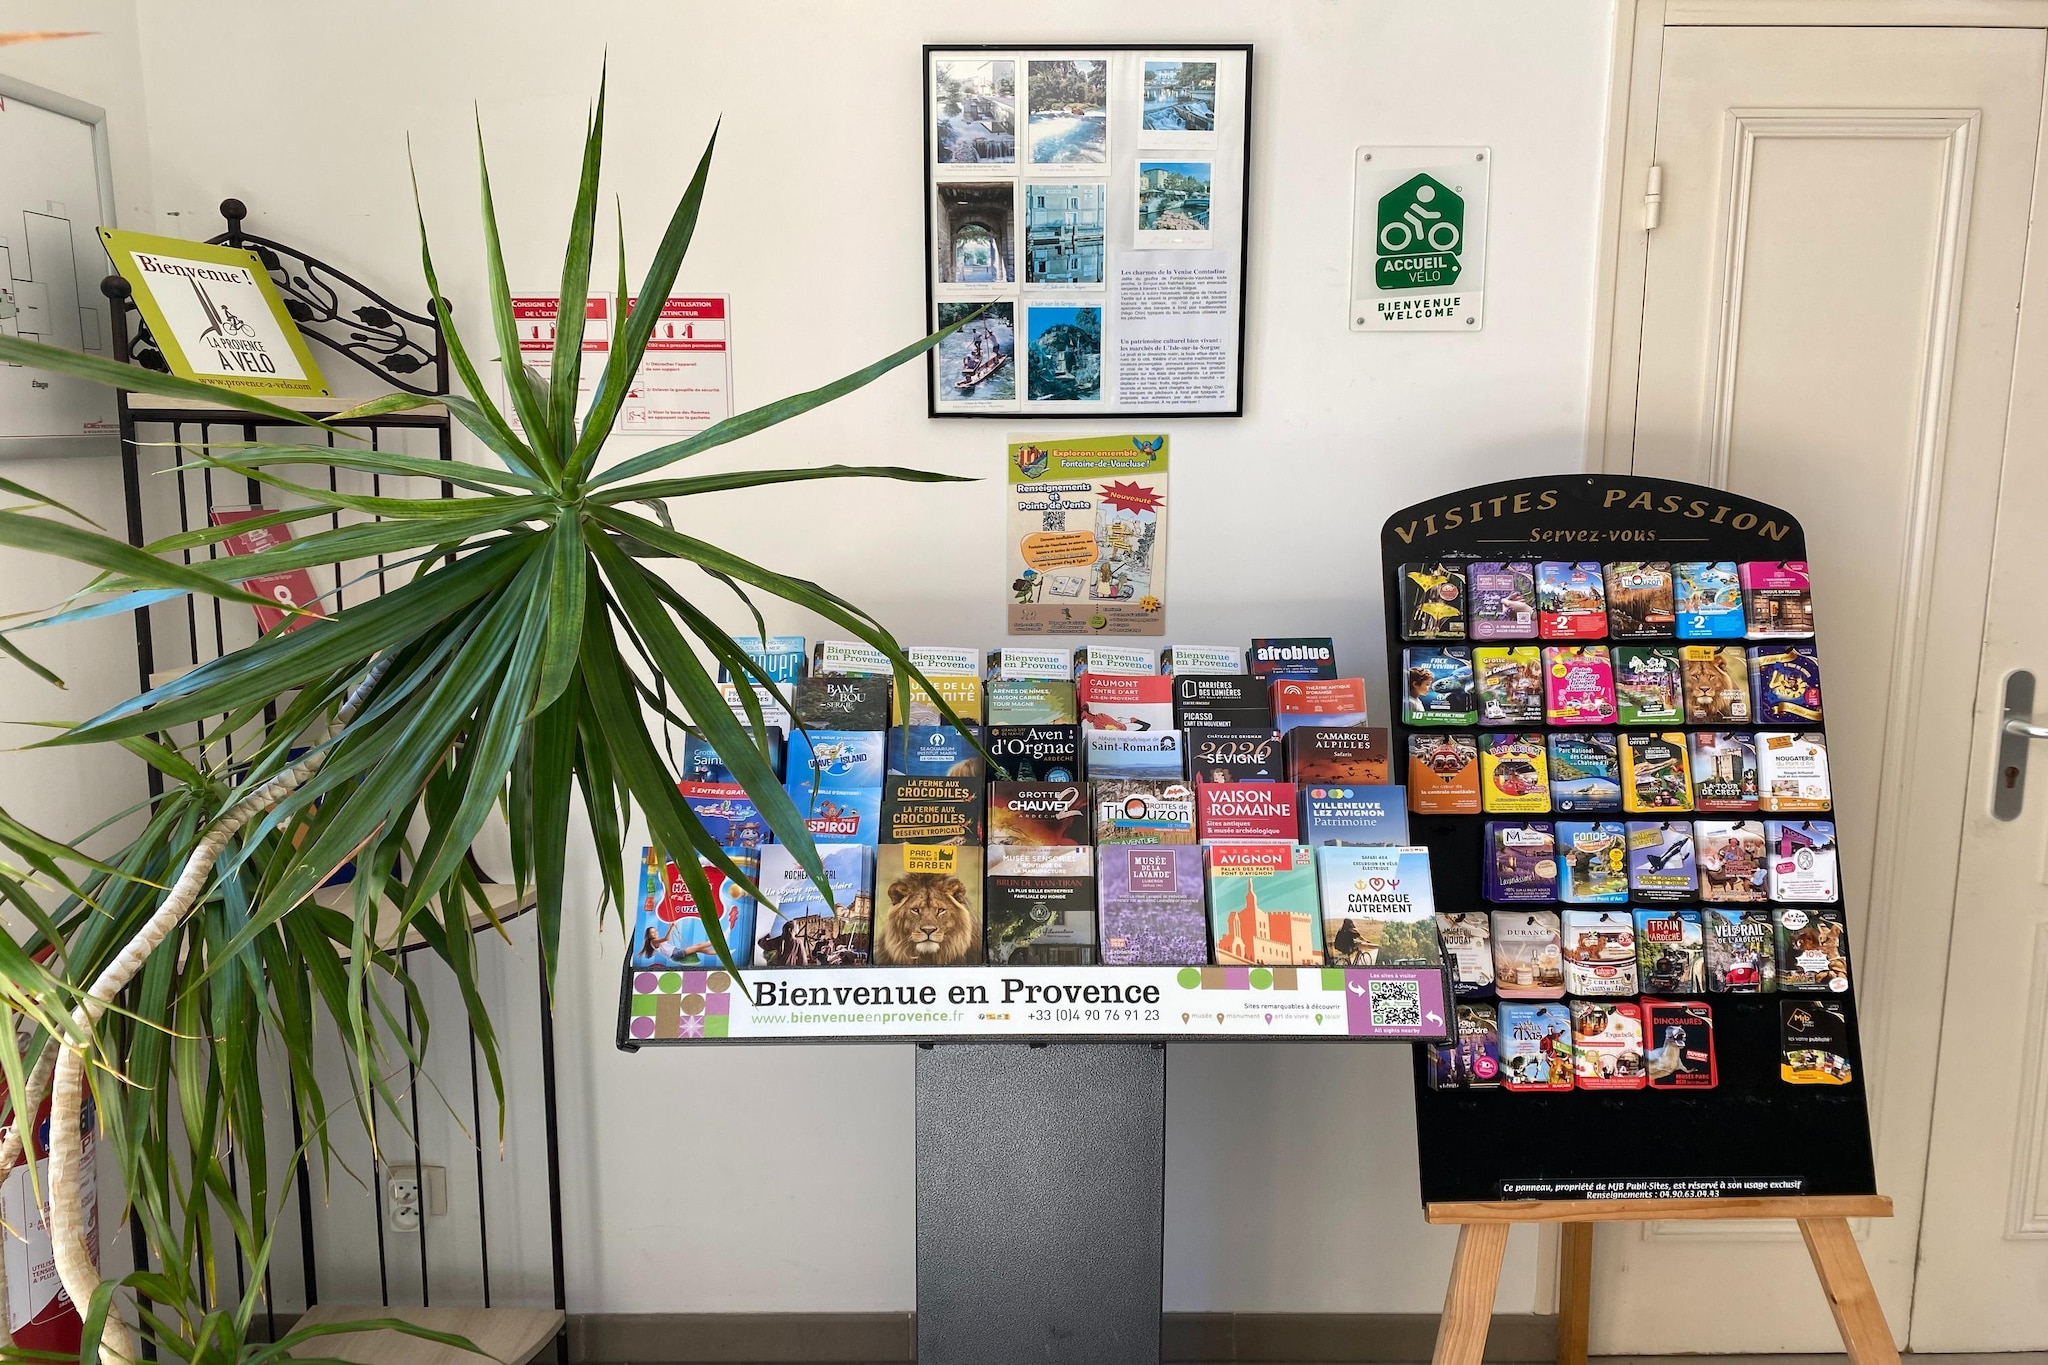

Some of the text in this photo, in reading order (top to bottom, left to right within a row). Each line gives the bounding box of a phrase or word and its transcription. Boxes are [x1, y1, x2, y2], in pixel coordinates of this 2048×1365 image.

[136, 254, 240, 284] Bienvenue
[1383, 256, 1447, 272] ACCUEIL
[1409, 269, 1440, 283] VÉLO
[1378, 297, 1461, 311] BIENVENUE
[1384, 308, 1454, 321] WELCOME
[207, 337, 266, 352] LA PROVENCE
[199, 379, 311, 390] www.provence-a-velo.com
[1052, 449, 1138, 458] Explorons ensemble
[1017, 484, 1091, 494] Renseignements
[1049, 493, 1060, 501] et
[1018, 501, 1091, 511] Points de Vente
[1394, 489, 1791, 545] VISITES PASSION
[1530, 527, 1657, 543] Servez-vous
[827, 646, 882, 657] Bienvenue
[1176, 651, 1230, 661] Bienvenue
[1258, 645, 1330, 661] afroblue
[842, 654, 891, 664] Provence
[912, 653, 967, 661] Bienvenue
[1004, 654, 1059, 663] Bienvenue
[1090, 652, 1144, 662] Bienvenue
[1020, 661, 1068, 670] Provence
[1106, 659, 1153, 670] Provence
[1192, 659, 1239, 668] Provence
[1090, 679, 1138, 688] CAUMONT
[1211, 688, 1241, 696] LUMIÈRES
[840, 694, 866, 703] BOU
[1024, 728, 1063, 742] Aven
[1316, 733, 1370, 741] CAMARGUE
[992, 739, 1074, 759] d'Orgnac
[1092, 742, 1159, 752] Saint-Roman
[1315, 741, 1370, 749] ALPILLES
[1207, 752, 1266, 764] SÉVIGNÉ
[897, 787, 969, 799] CROCODILES
[1018, 791, 1060, 799] GROTTE
[1207, 791, 1271, 802] VAISON
[1008, 800, 1071, 811] CHAUVET
[1212, 804, 1290, 816] ROMAINE
[893, 813, 966, 824] CROCODILES
[1314, 818, 1377, 826] Patrimoine
[808, 821, 855, 833] SPIROU
[1135, 856, 1167, 864] MUSÉE
[1221, 855, 1282, 864] AVIGNON
[1348, 894, 1410, 903] CAMARGUE
[1348, 904, 1412, 912] AUTREMENT
[1650, 921, 1679, 931] TRAIN
[752, 978, 1160, 1007] Bienvenue en Provence
[751, 1010, 964, 1025] www.bienvenueenprovence.fr
[1028, 1010, 1160, 1021] +33 (0)4 90 76 91 23
[1515, 1184, 1553, 1193] panneau,
[1555, 1183, 1594, 1192] propriété
[1608, 1183, 1624, 1191] MJB
[1626, 1182, 1671, 1191] Publi-Sites,
[1744, 1182, 1768, 1190] usage
[1770, 1180, 1801, 1190] exclusif
[1587, 1190, 1719, 1199] Renseignements 04.90.63.04.43
